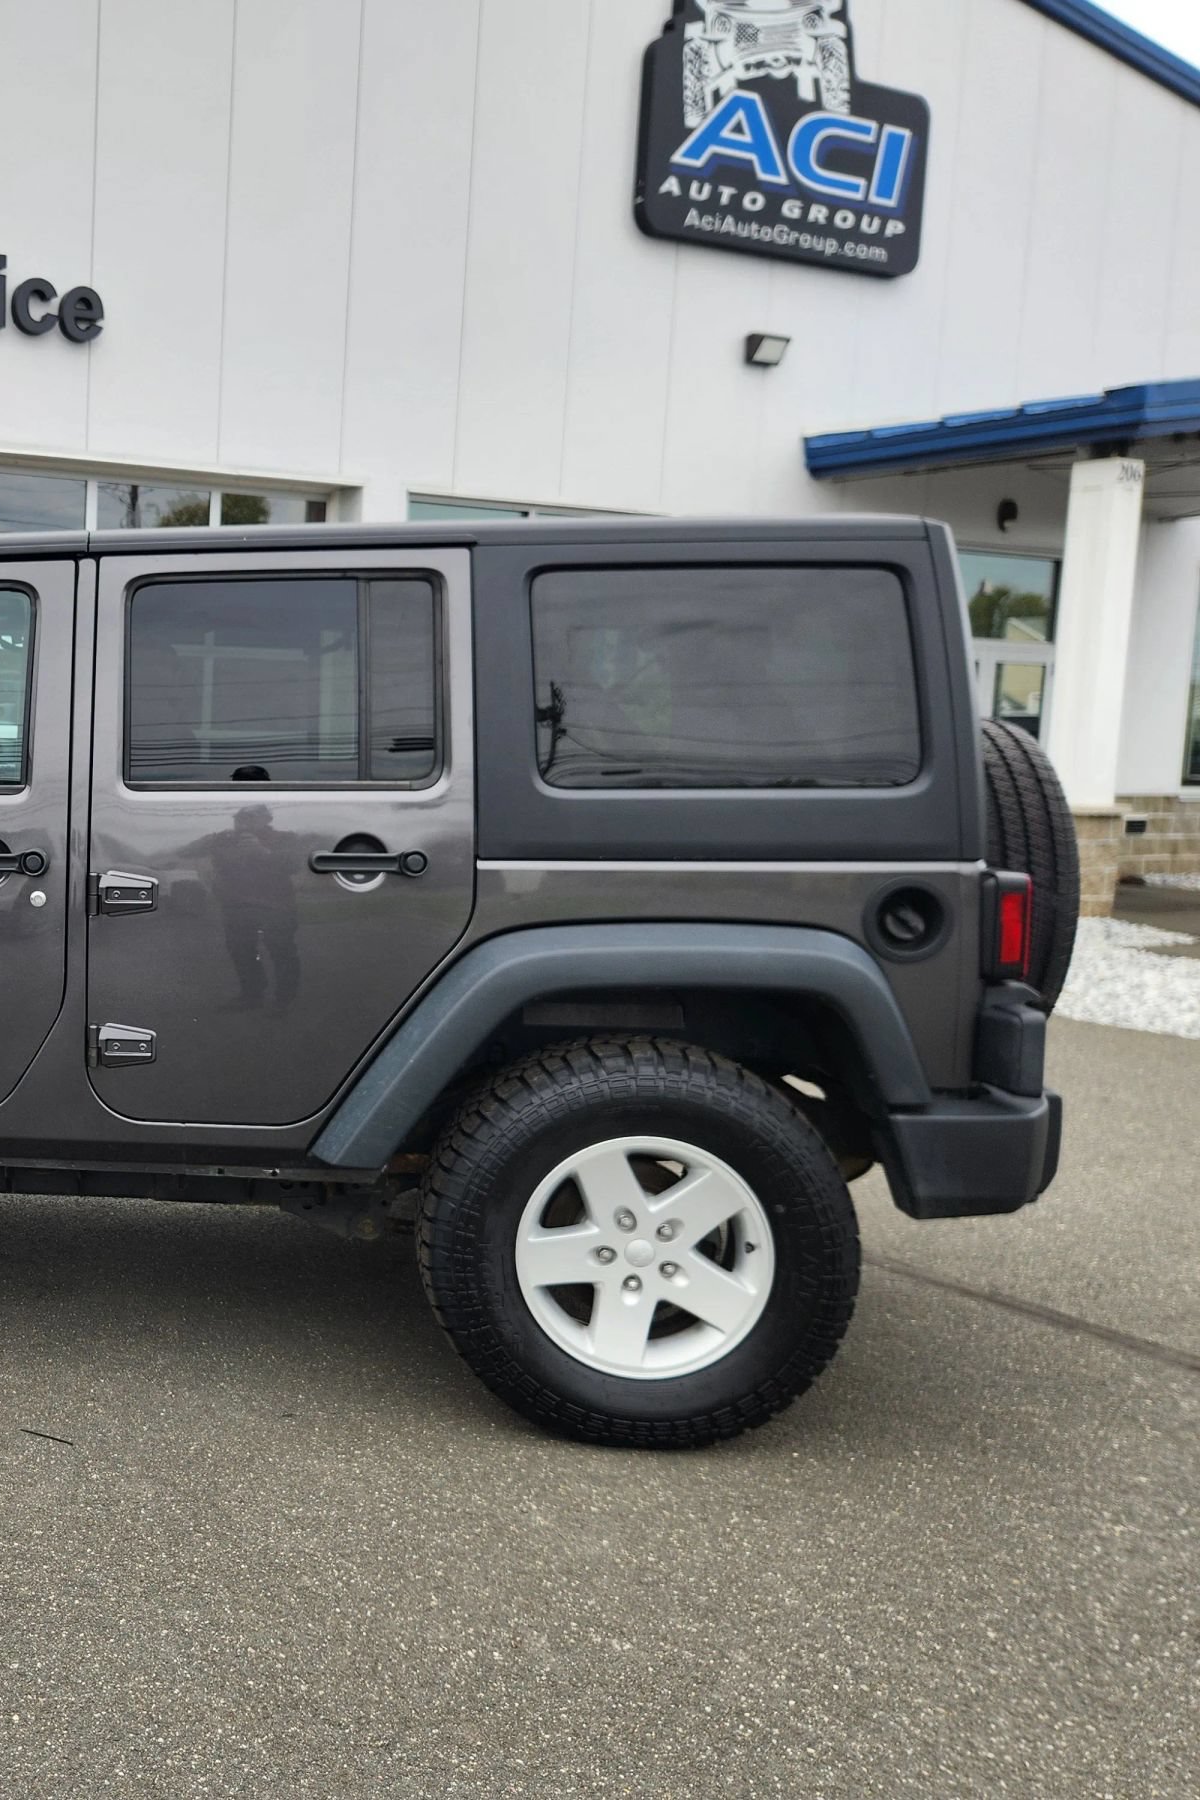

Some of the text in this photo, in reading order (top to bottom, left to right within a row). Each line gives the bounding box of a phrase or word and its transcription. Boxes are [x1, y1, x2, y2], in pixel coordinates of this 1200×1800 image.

[669, 88, 913, 208] ACI
[658, 174, 906, 239] AUTO GROUP
[683, 207, 888, 263] AciAutoGroup.com
